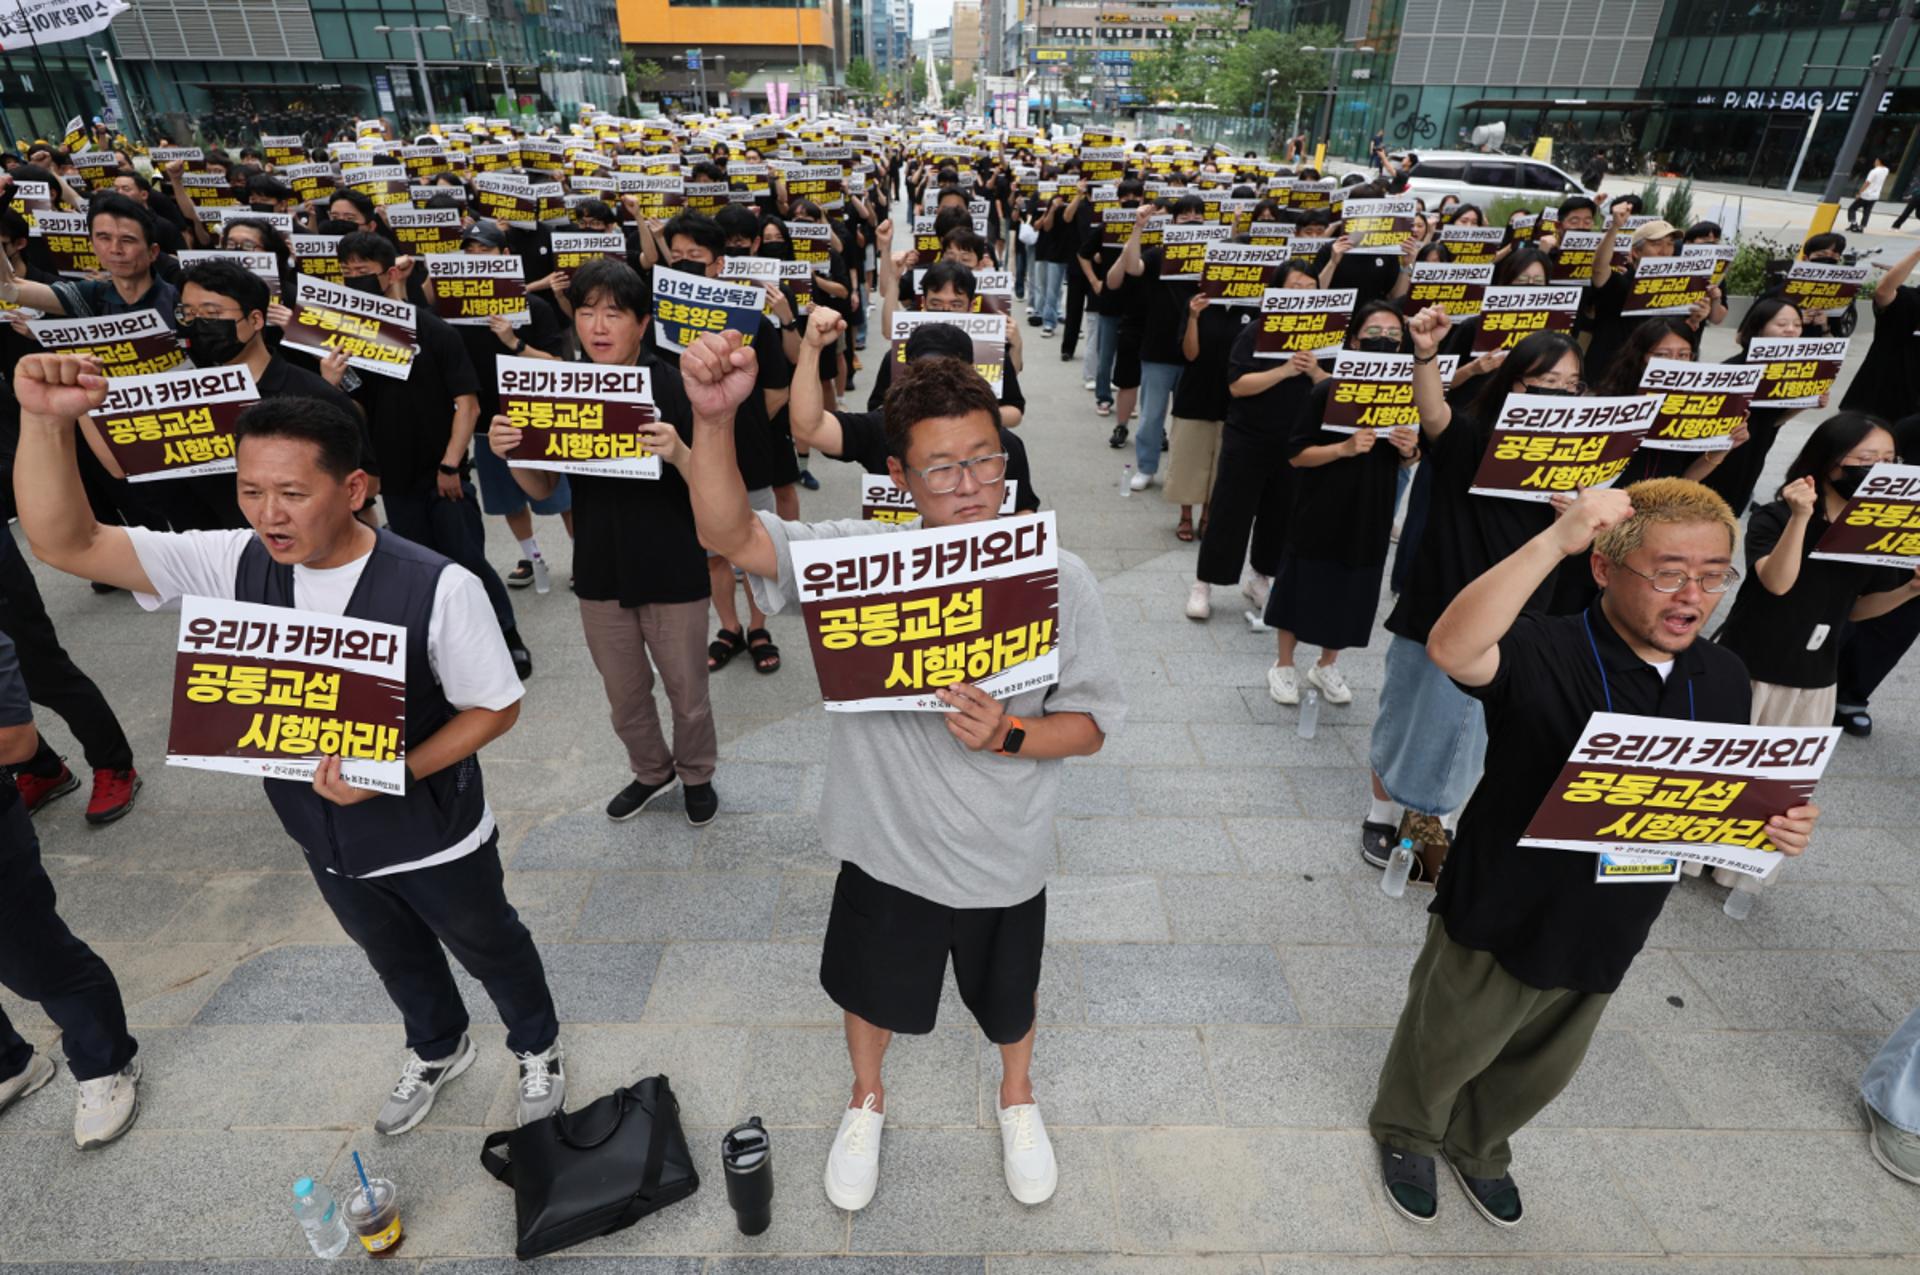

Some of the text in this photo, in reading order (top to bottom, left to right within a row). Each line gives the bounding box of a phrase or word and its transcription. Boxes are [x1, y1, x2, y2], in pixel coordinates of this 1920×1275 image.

[1392, 94, 1409, 118] P
[1345, 202, 1414, 215] 우리가 카카오다
[39, 219, 71, 232] 우리가
[1166, 228, 1230, 241] 우리가 카카오다
[1345, 218, 1394, 232] 공동교섭
[295, 241, 326, 254] 우리가
[554, 236, 622, 249] 우리가 카카오다
[1206, 249, 1288, 262] 우리가 카카오다
[430, 259, 518, 275] 우리가 카카오다
[1206, 265, 1263, 281] 공동교섭
[1414, 268, 1490, 281] 우리가 카카오다
[1640, 259, 1714, 276] 우리가 카카오다
[1792, 267, 1868, 280] 우리가 카카오다
[436, 279, 494, 298] 공동교섭
[657, 278, 758, 306] 81억 보상독점
[1411, 284, 1467, 300] 공동교섭
[1634, 277, 1691, 294] 공동교섭
[1785, 281, 1842, 296] 공동교섭
[300, 285, 411, 321] 우리가 카카오다
[1265, 293, 1353, 311] 우리가 카카오다
[1485, 291, 1577, 309] 우리가 카카오다
[298, 305, 381, 339] 공동교섭
[658, 300, 728, 330] 윤호영은
[1264, 314, 1328, 332] 공동교섭
[1482, 312, 1549, 330] 공동교섭
[39, 314, 158, 345] 우리가 카카오다
[1750, 341, 1846, 360] 우리가 카카오다
[1336, 361, 1388, 378] 우리가
[1644, 369, 1761, 388] 우리가 카카오다
[155, 371, 246, 402] 카카오다
[501, 370, 644, 393] 우리가 카카오다
[1502, 400, 1657, 428] 우리가 카카오다
[1659, 394, 1727, 416] 동교섭
[507, 401, 604, 430] 공동교섭
[106, 407, 215, 444] 공동교섭
[1494, 435, 1609, 462] 공동교섭
[803, 521, 1047, 597] 우리가 카카오다
[818, 587, 983, 650] 공동교섭
[184, 617, 398, 664] 우리가 카카오다
[884, 619, 1054, 689] 시행하라!
[186, 663, 342, 711] 공동교섭
[237, 713, 399, 763] 시행하라!
[1578, 732, 1829, 768] 우리가 카카오다
[1562, 770, 1748, 812] 공동교섭
